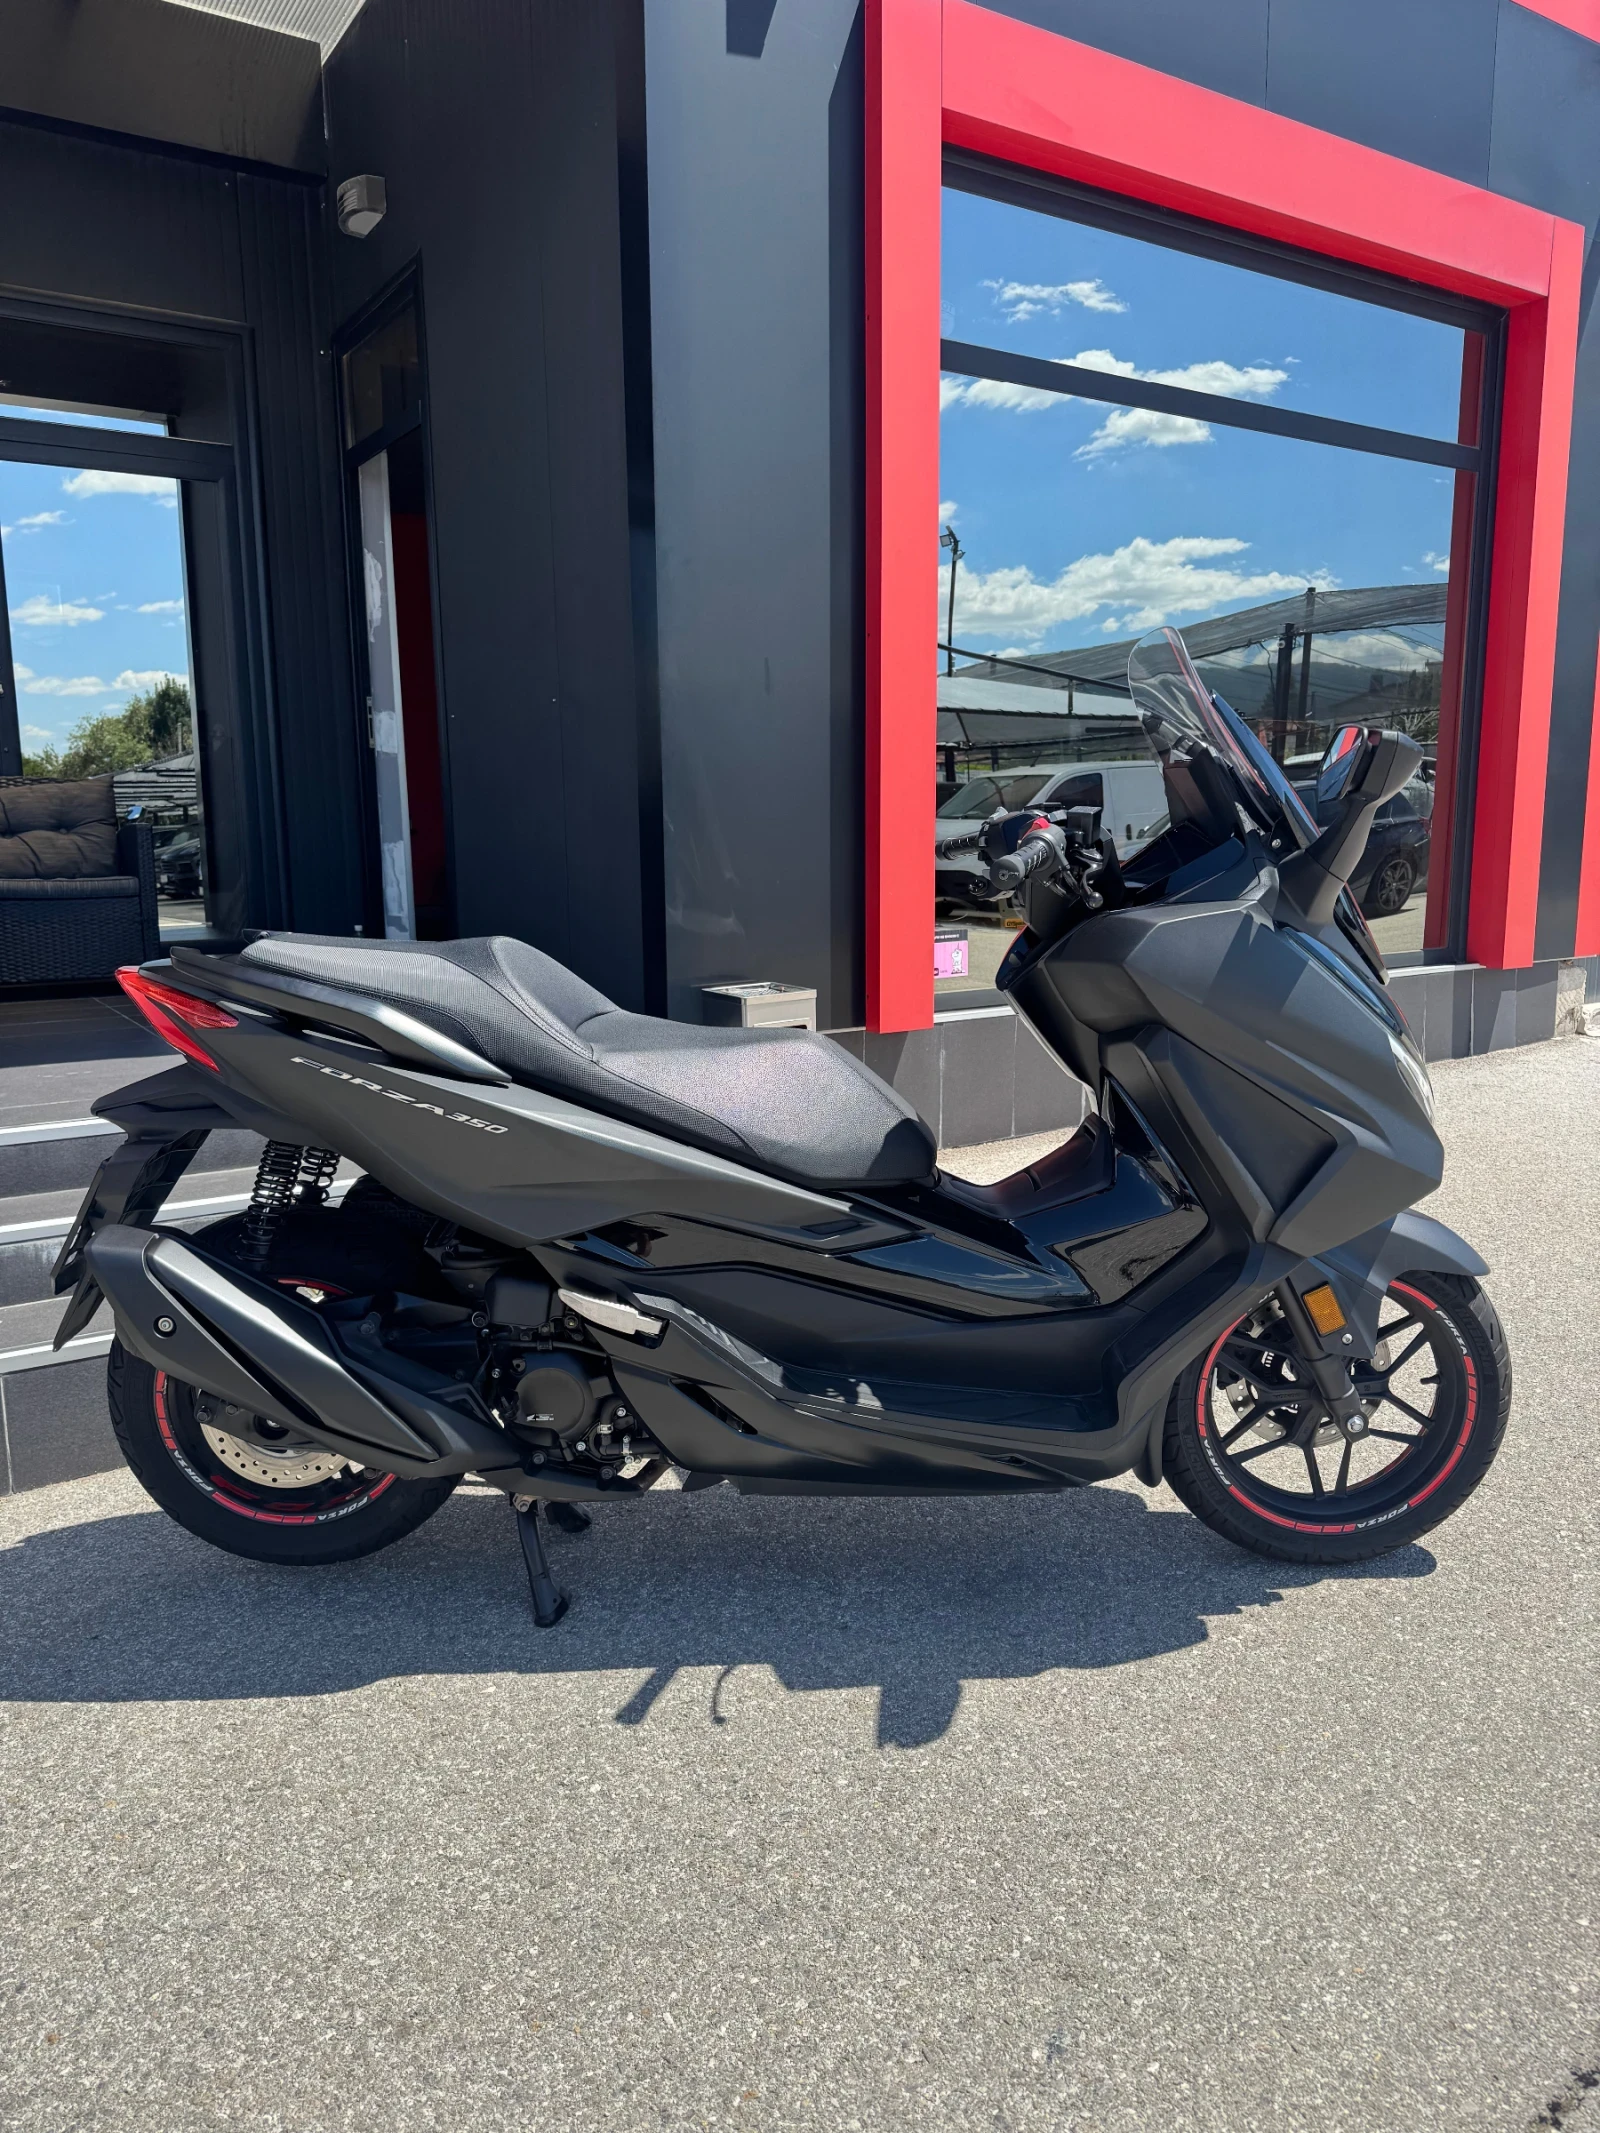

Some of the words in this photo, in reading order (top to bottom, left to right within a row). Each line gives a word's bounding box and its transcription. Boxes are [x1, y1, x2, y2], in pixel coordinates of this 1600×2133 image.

[1435, 1310, 1468, 1355] FORZA
[174, 1450, 214, 1491] FORZA
[1182, 1433, 1224, 1501] MICHELIN
[1203, 1439, 1231, 1485] FORZA
[317, 1496, 368, 1521] FORZA
[1356, 1503, 1409, 1529] FORZA
